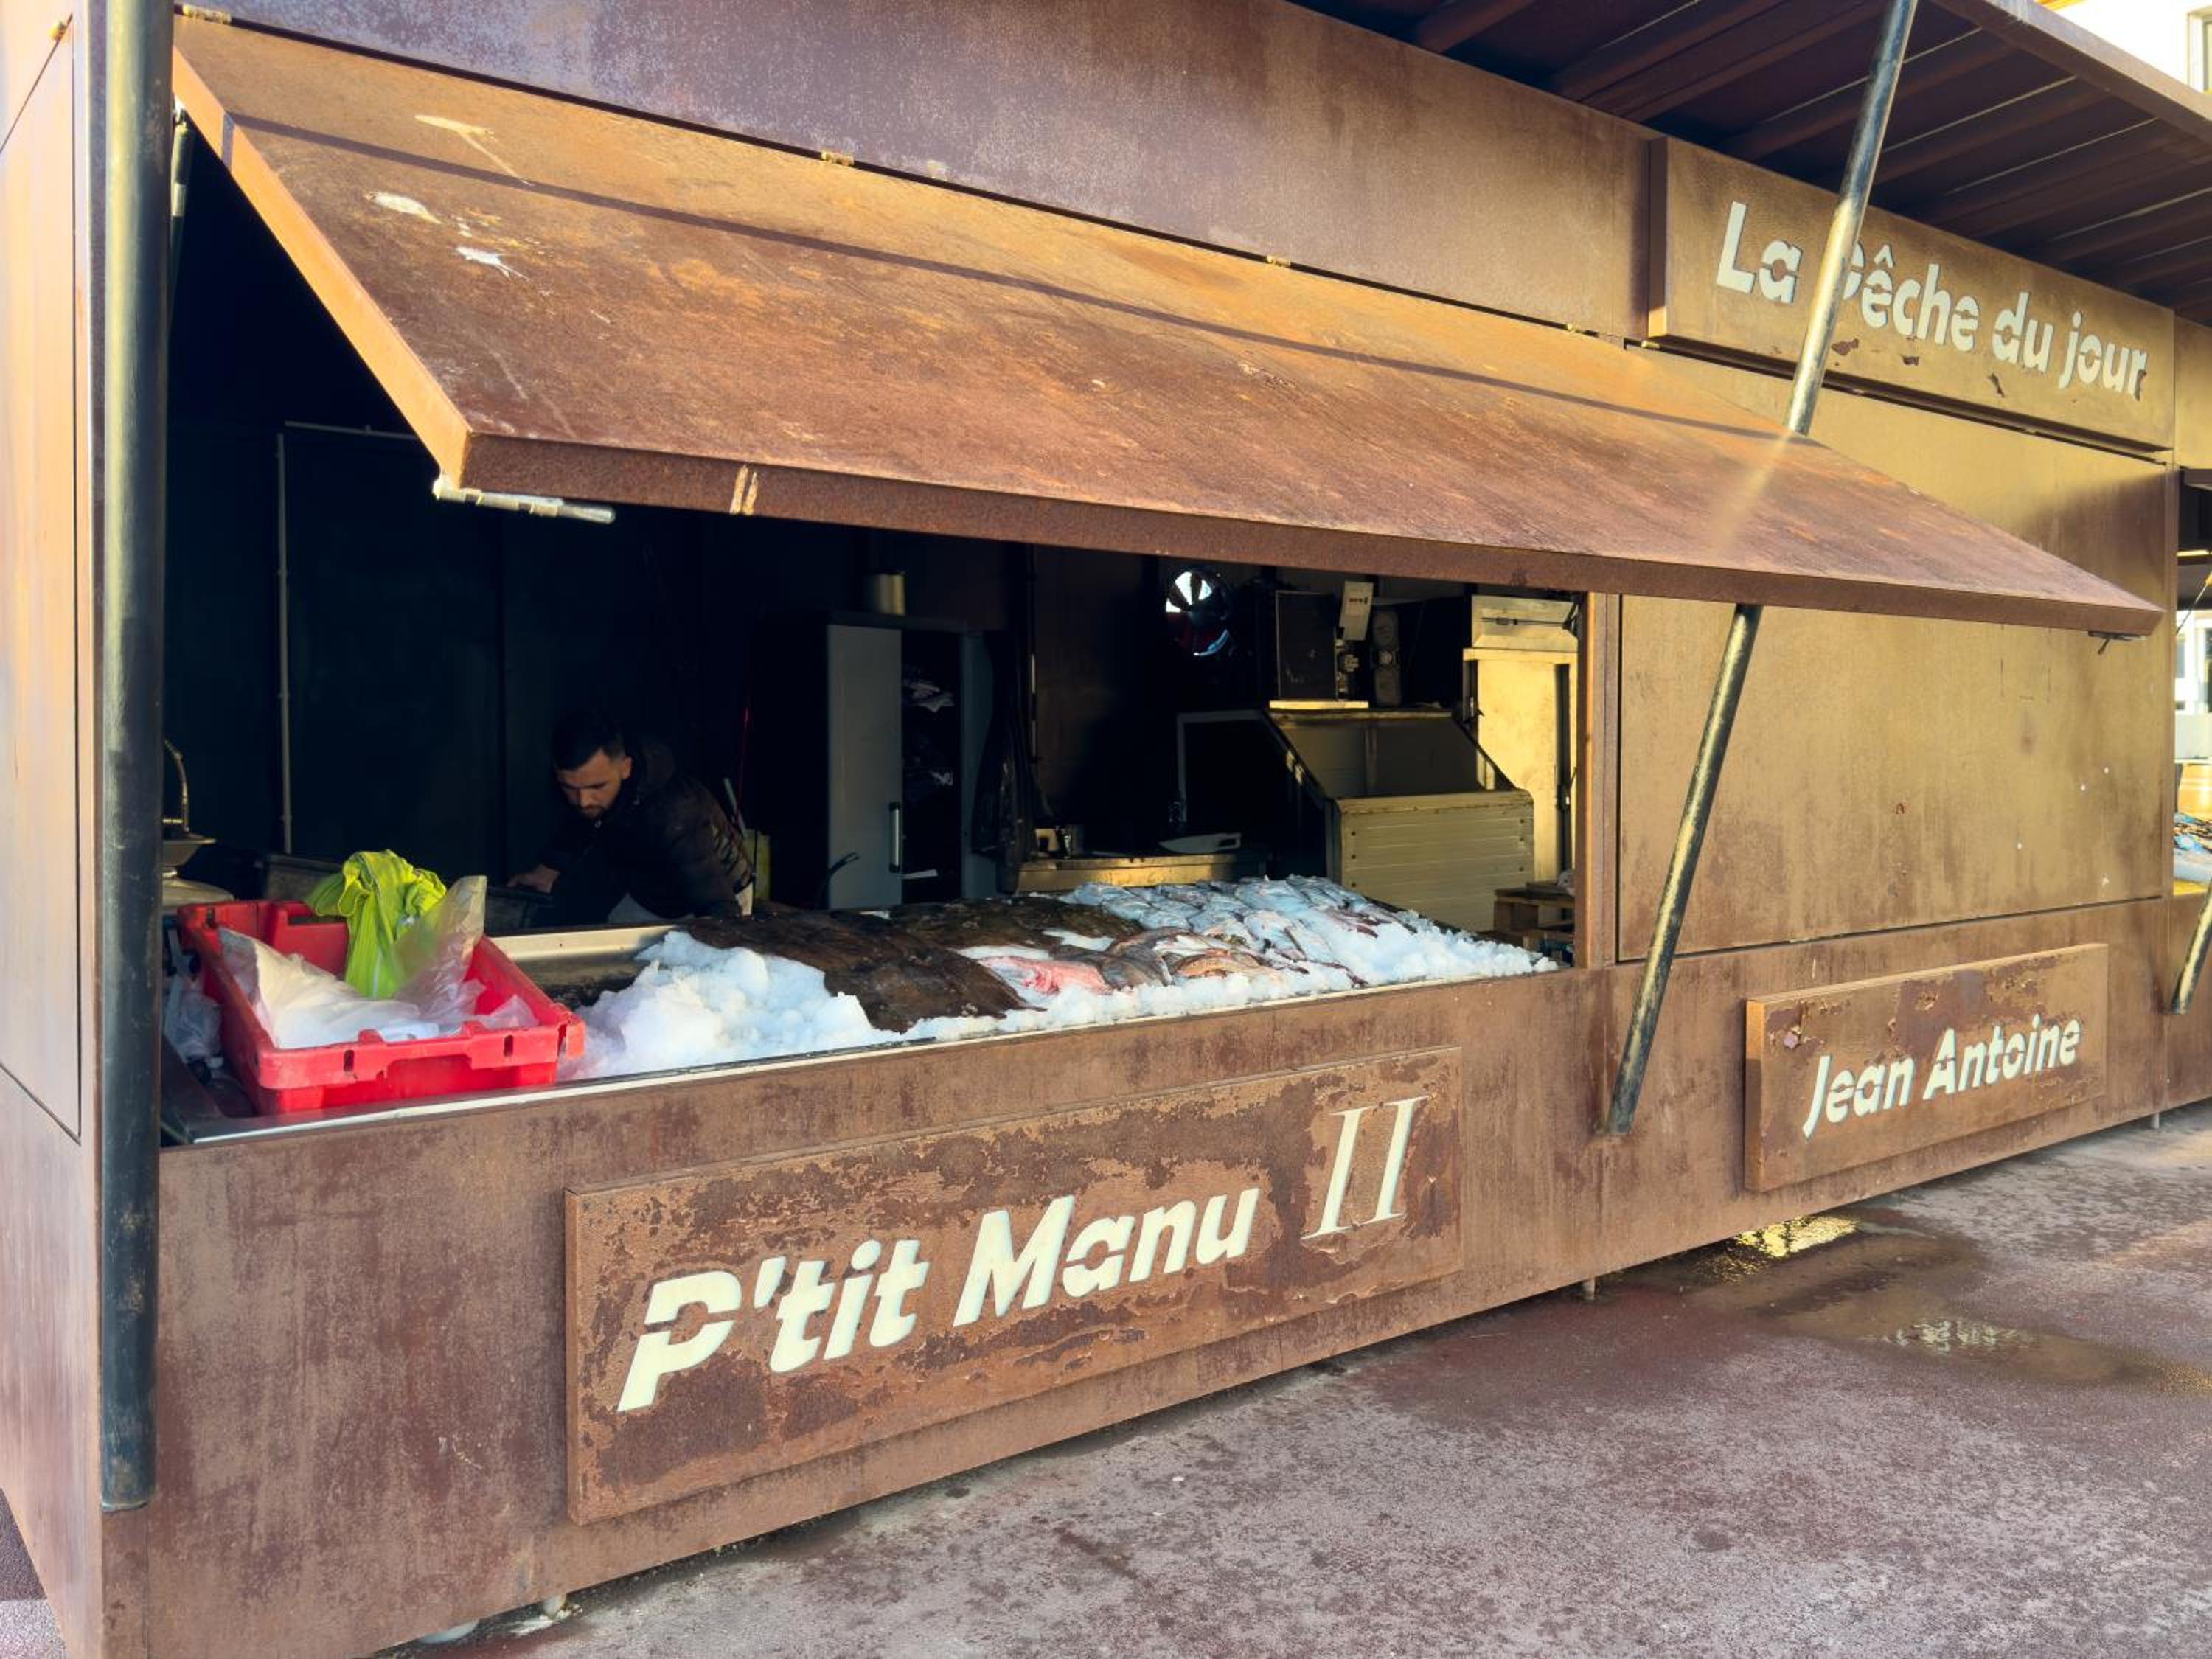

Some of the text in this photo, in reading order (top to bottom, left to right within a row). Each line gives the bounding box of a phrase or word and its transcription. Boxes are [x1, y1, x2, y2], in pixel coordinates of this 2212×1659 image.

[1717, 201, 1801, 303] La
[1992, 292, 2052, 372] du
[2059, 310, 2147, 399] jour
[1803, 1013, 2081, 1138] Jean Antoine
[617, 1096, 1428, 1412] P'tit Manu II
